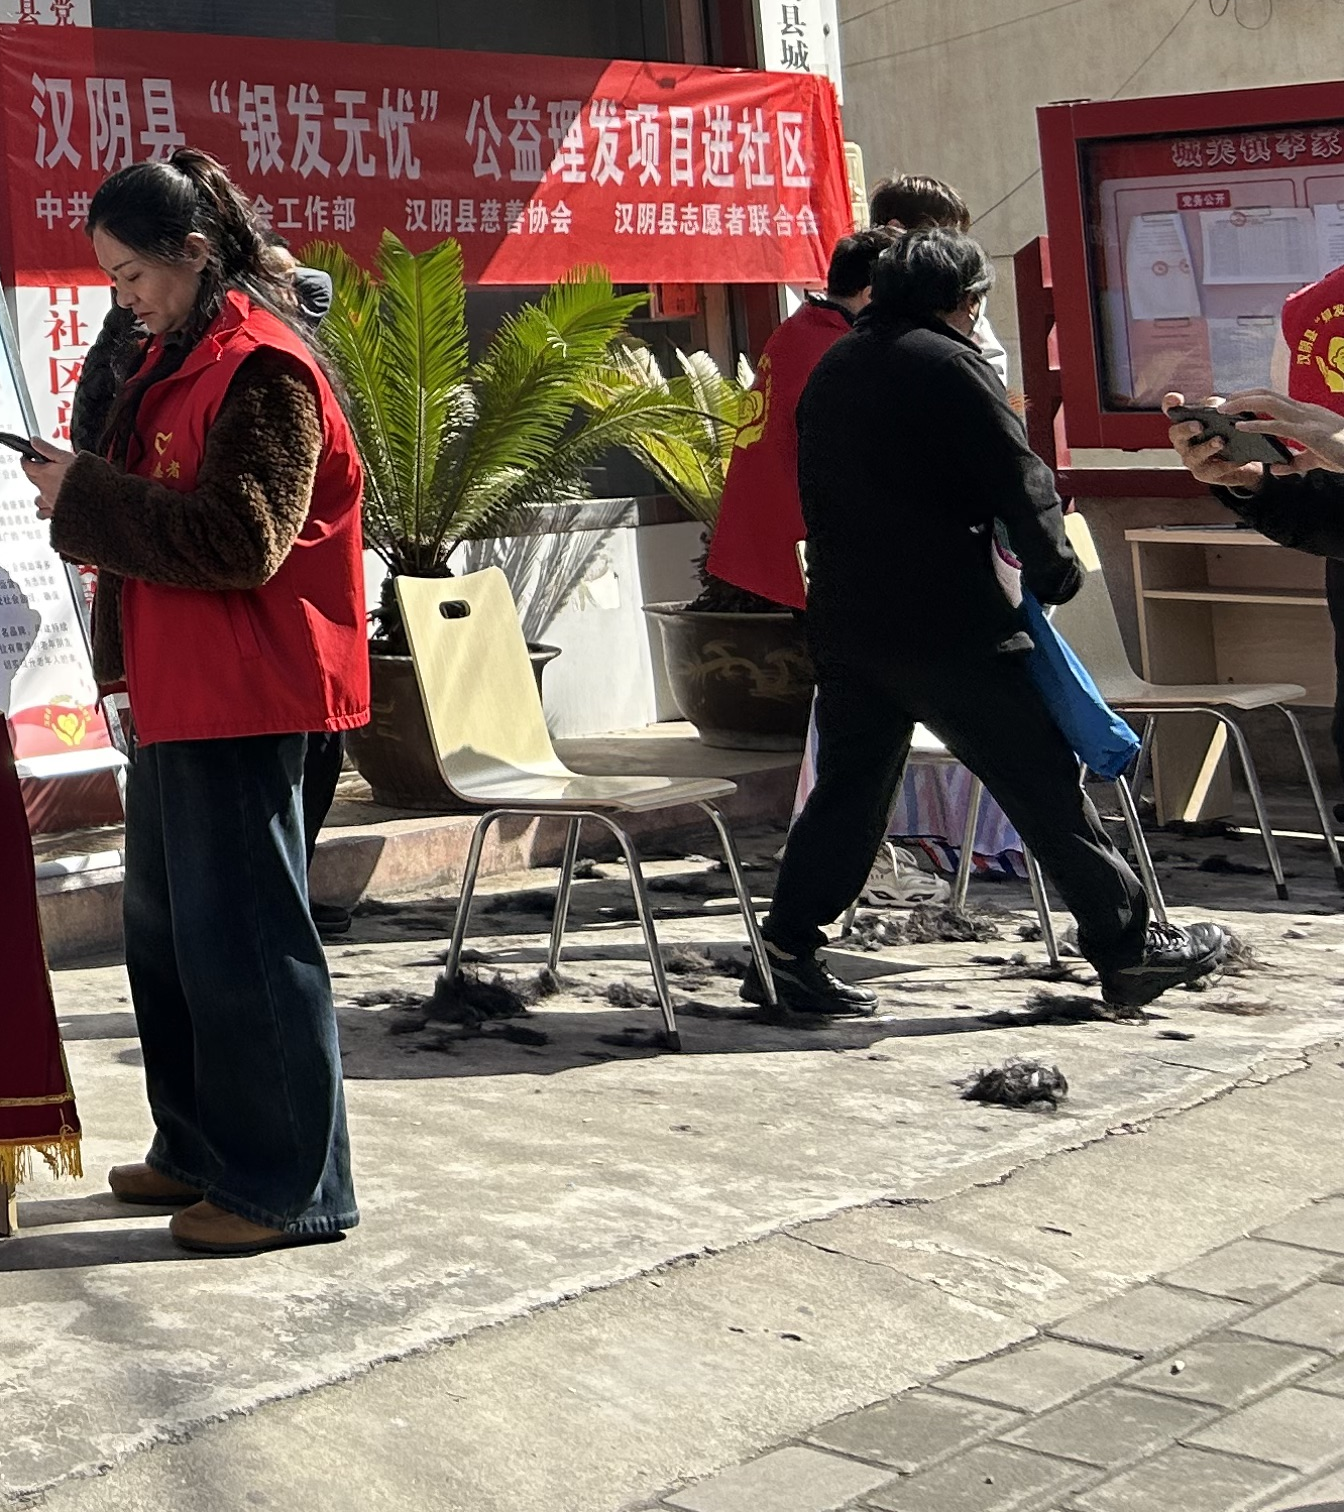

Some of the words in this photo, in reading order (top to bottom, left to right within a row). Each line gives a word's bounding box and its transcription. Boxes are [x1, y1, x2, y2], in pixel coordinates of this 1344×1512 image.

[405, 199, 573, 235] 汉阴县慈善协会
[615, 203, 819, 237] 汉阴县志愿者联合会
